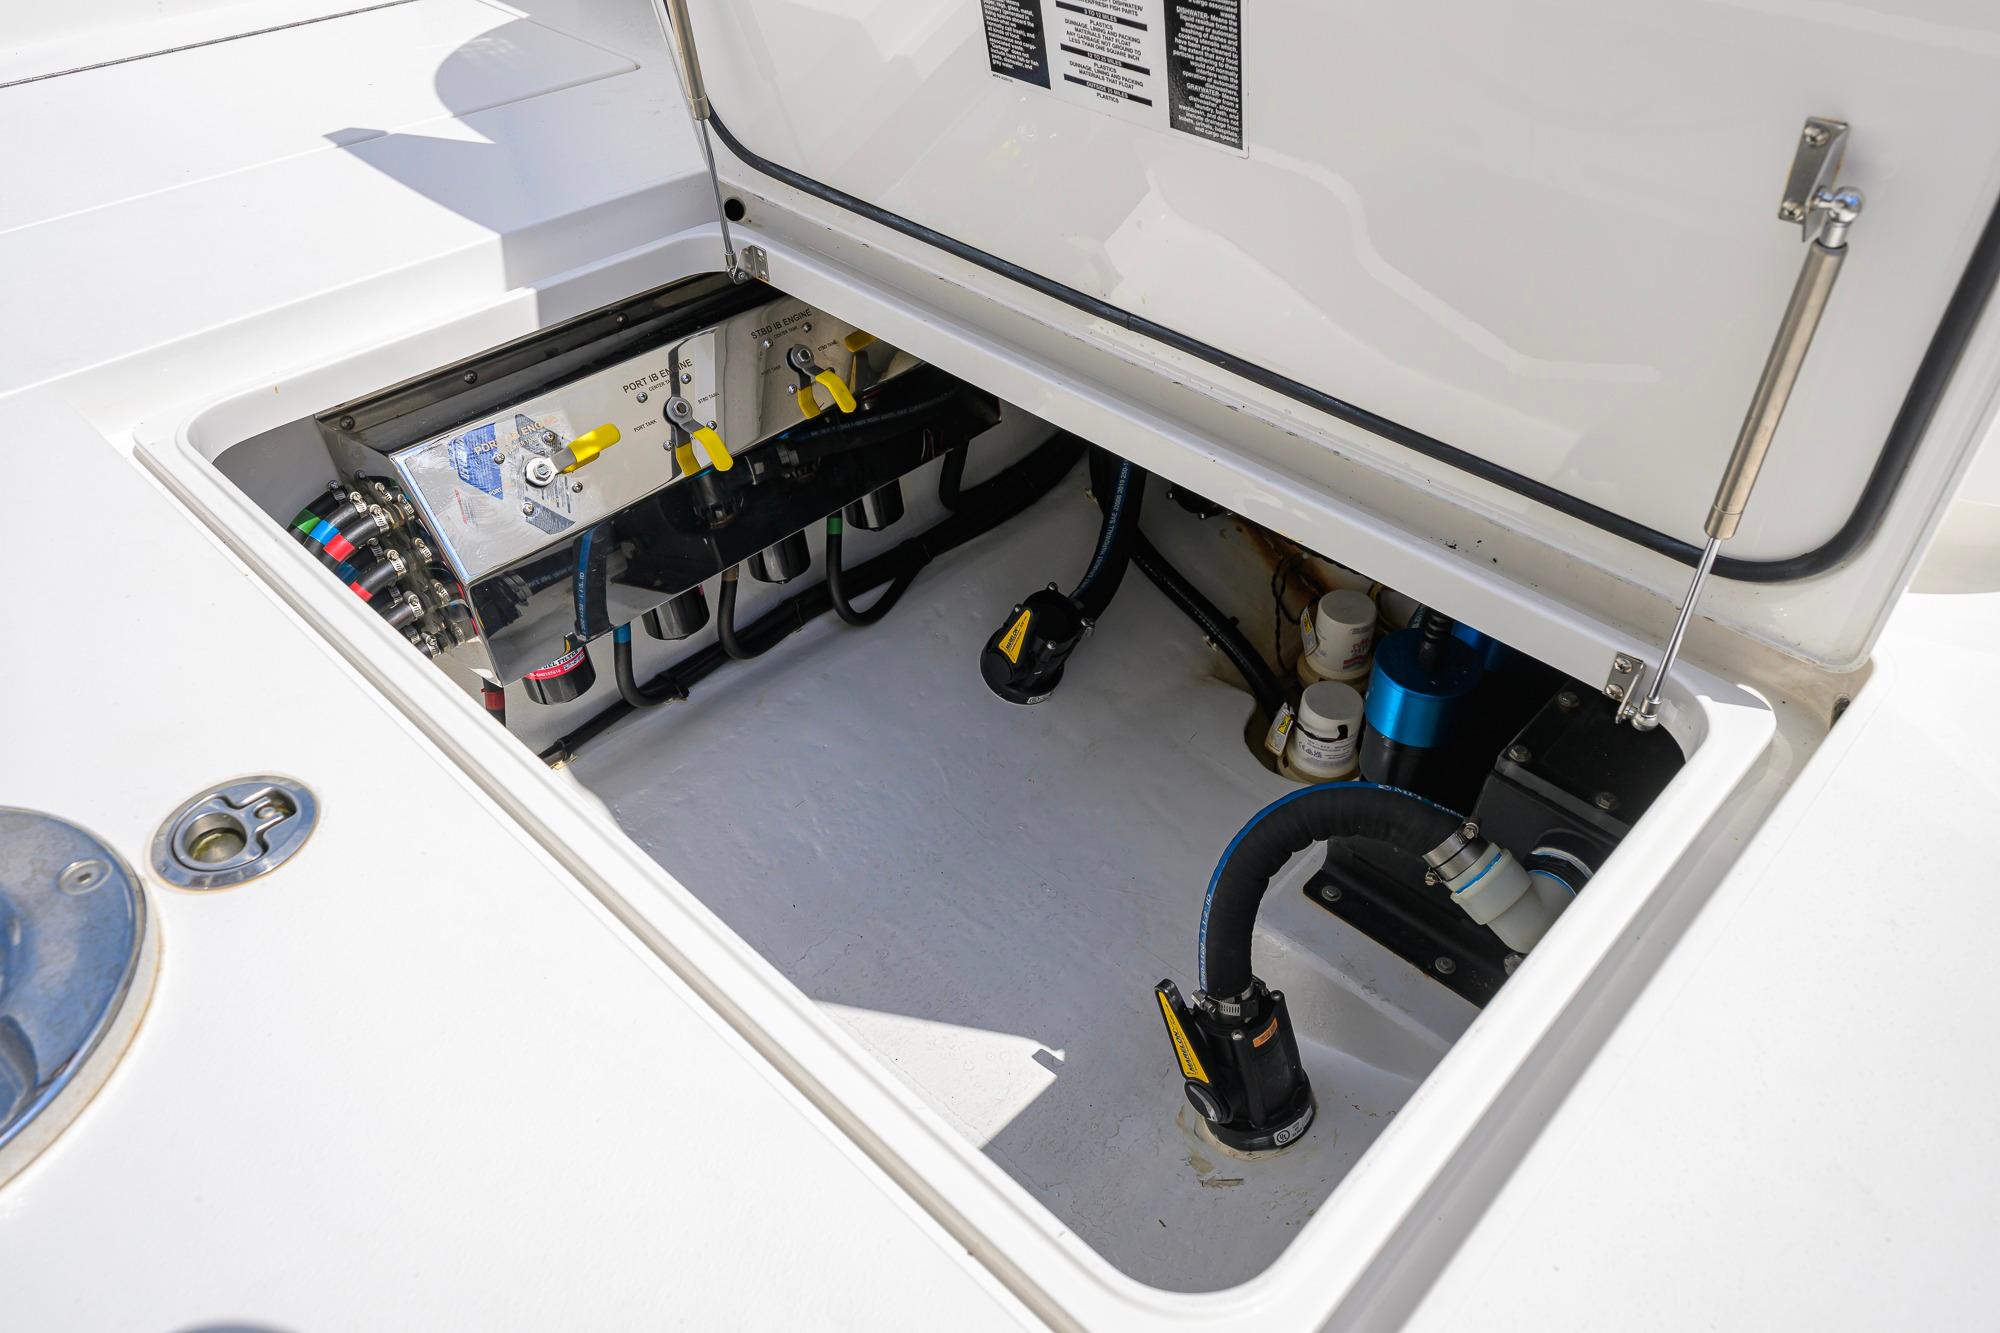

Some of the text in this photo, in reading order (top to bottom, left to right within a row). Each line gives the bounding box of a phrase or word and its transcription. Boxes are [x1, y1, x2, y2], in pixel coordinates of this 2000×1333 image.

[1088, 9, 1095, 17] TO
[1102, 13, 1118, 23] MILES
[1110, 4, 1138, 17] FISH PARTS
[1090, 19, 1113, 30] PLASTICS
[1195, 18, 1214, 28] residue
[1216, 22, 1228, 32] from
[1229, 26, 1238, 34] the
[1211, 14, 1228, 24] Means
[1065, 18, 1089, 30] DUNNAGE,
[1090, 25, 1106, 34] LINING
[1118, 33, 1140, 44] PACKING
[1075, 27, 1100, 39] MATERIALS
[1115, 38, 1131, 47] FLOAT
[1181, 26, 1202, 38] washing
[1209, 34, 1226, 44] dishes
[1227, 39, 1238, 47] and
[1185, 21, 1204, 32] manual
[1212, 28, 1238, 40] automatic
[1077, 33, 1100, 44] GARBAGE
[1112, 43, 1133, 54] GROUND
[1175, 37, 1187, 46] have
[1188, 41, 1200, 49] been
[1178, 32, 1198, 44] cooking
[1081, 40, 1094, 48] THAN
[1095, 44, 1105, 52] ONE
[1106, 48, 1126, 58] SQUARE
[1128, 53, 1139, 61] INCH
[1179, 44, 1238, 66] the extent that any food
[1094, 63, 1116, 73] PLASTICS
[1107, 57, 1122, 67] MILES
[1195, 55, 1218, 68] adhering
[1225, 64, 1238, 72] them
[1190, 60, 1238, 79] would not normally
[1079, 69, 1134, 90] MATERIALS THAT FLOAT
[1094, 68, 1109, 77] LINING
[1122, 76, 1143, 87] PACKING
[1182, 70, 1206, 82] operation
[1213, 79, 1238, 91] automatic
[1218, 74, 1229, 82] with
[1230, 77, 1238, 85] the
[1097, 92, 1119, 104] PLASTICS
[1114, 89, 1129, 99] MILES
[1200, 93, 1221, 104] drainage
[1222, 98, 1234, 107] from
[1222, 92, 1239, 103] Means
[1186, 112, 1239, 132] include drainage from
[1207, 112, 1216, 120] and
[1217, 115, 1230, 124] does
[1229, 112, 1239, 121] and
[1195, 125, 1204, 133] and
[1205, 129, 1220, 139] cargo
[751, 308, 812, 340] STBD IB ENGINE
[623, 358, 693, 394] PORT IB ENGINE
[648, 382, 665, 392] CENTER
[698, 396, 709, 404] STBD
[634, 420, 657, 433] PORT TANK
[474, 440, 498, 454] POR
